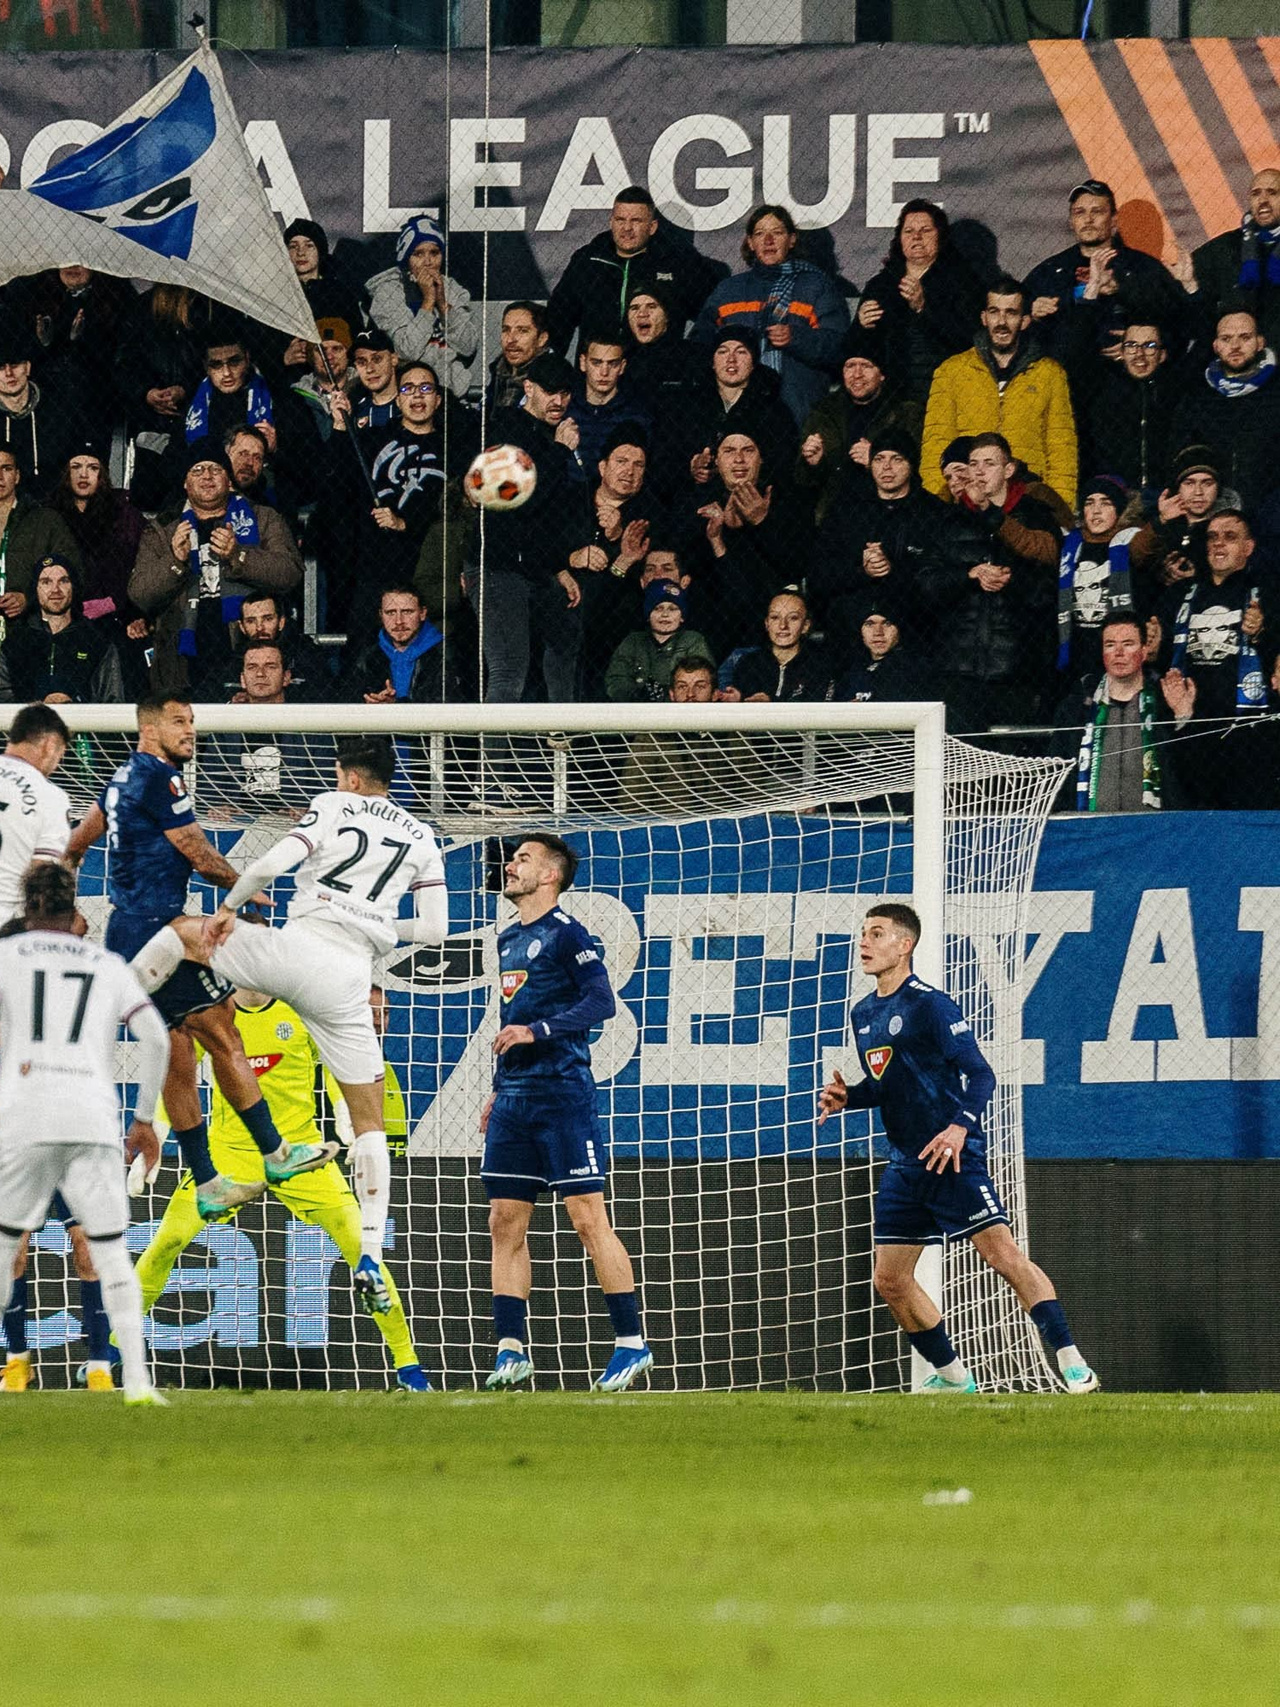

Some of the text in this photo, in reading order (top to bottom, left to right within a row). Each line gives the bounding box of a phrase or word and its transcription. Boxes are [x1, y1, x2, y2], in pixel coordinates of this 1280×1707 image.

[363, 113, 946, 233] LEAGUE
[317, 826, 412, 902] 27
[32, 970, 95, 1043] 17
[552, 886, 1280, 1088] BETYA
